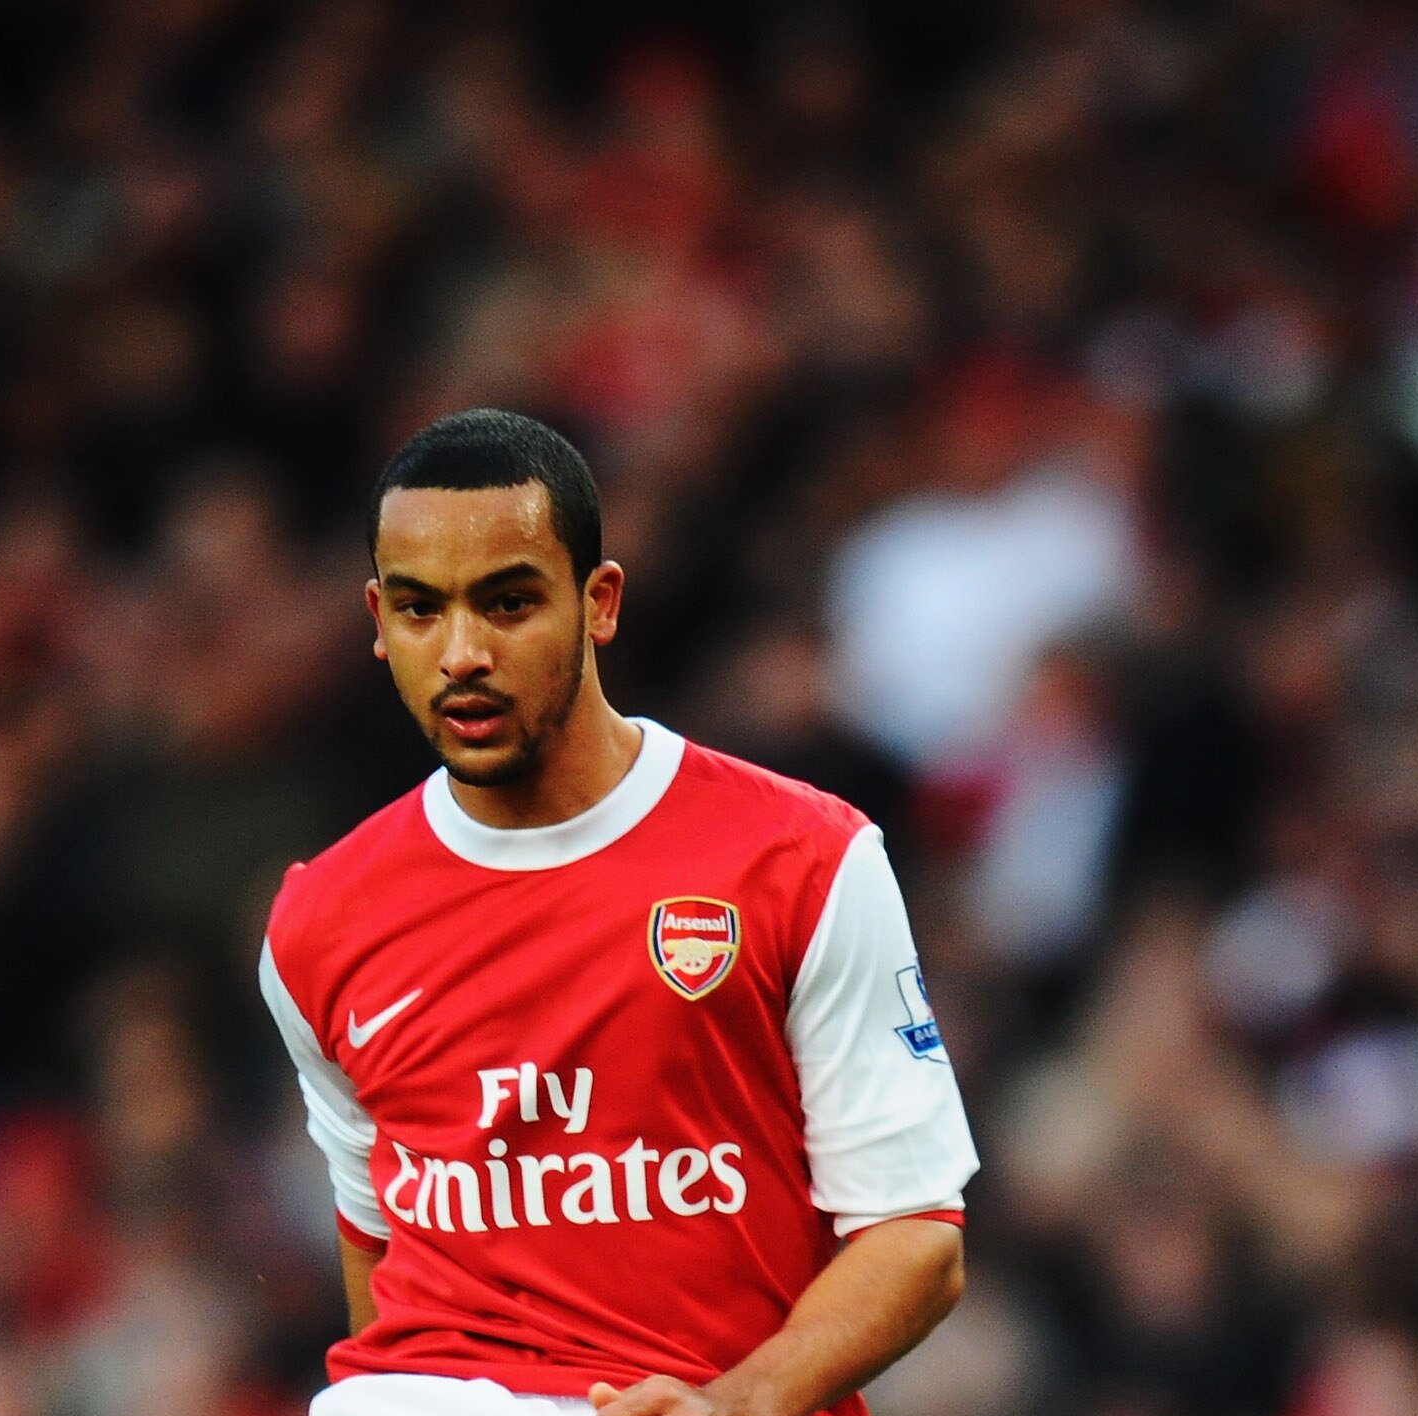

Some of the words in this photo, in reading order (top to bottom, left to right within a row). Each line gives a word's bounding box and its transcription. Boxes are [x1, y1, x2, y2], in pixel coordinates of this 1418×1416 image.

[664, 913, 727, 931] Arsenal
[478, 1062, 593, 1134] Fly
[385, 1137, 746, 1232] Emirates
